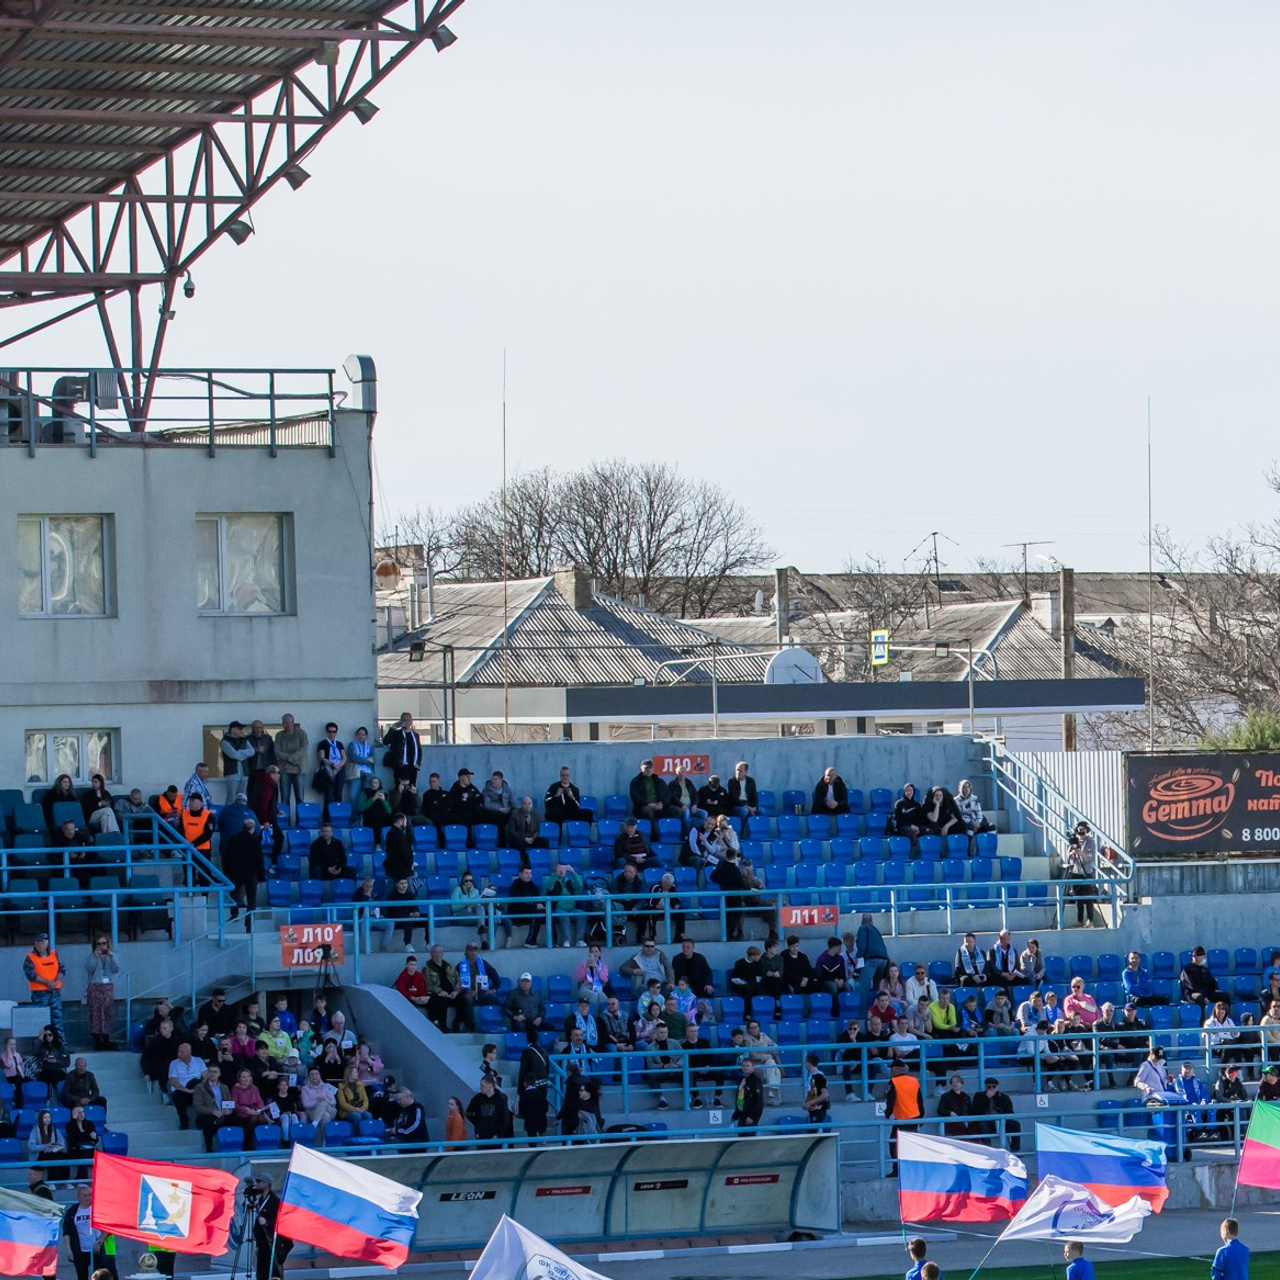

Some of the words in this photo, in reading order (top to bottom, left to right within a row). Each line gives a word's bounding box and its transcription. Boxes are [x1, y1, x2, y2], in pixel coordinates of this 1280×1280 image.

[1143, 794, 1230, 824] Gemma
[1241, 828, 1251, 841] 8
[1253, 827, 1280, 841] 800
[790, 909, 819, 924] Л11
[302, 927, 334, 943] Л10
[292, 948, 324, 964] Л09
[538, 1259, 552, 1269] ФК
